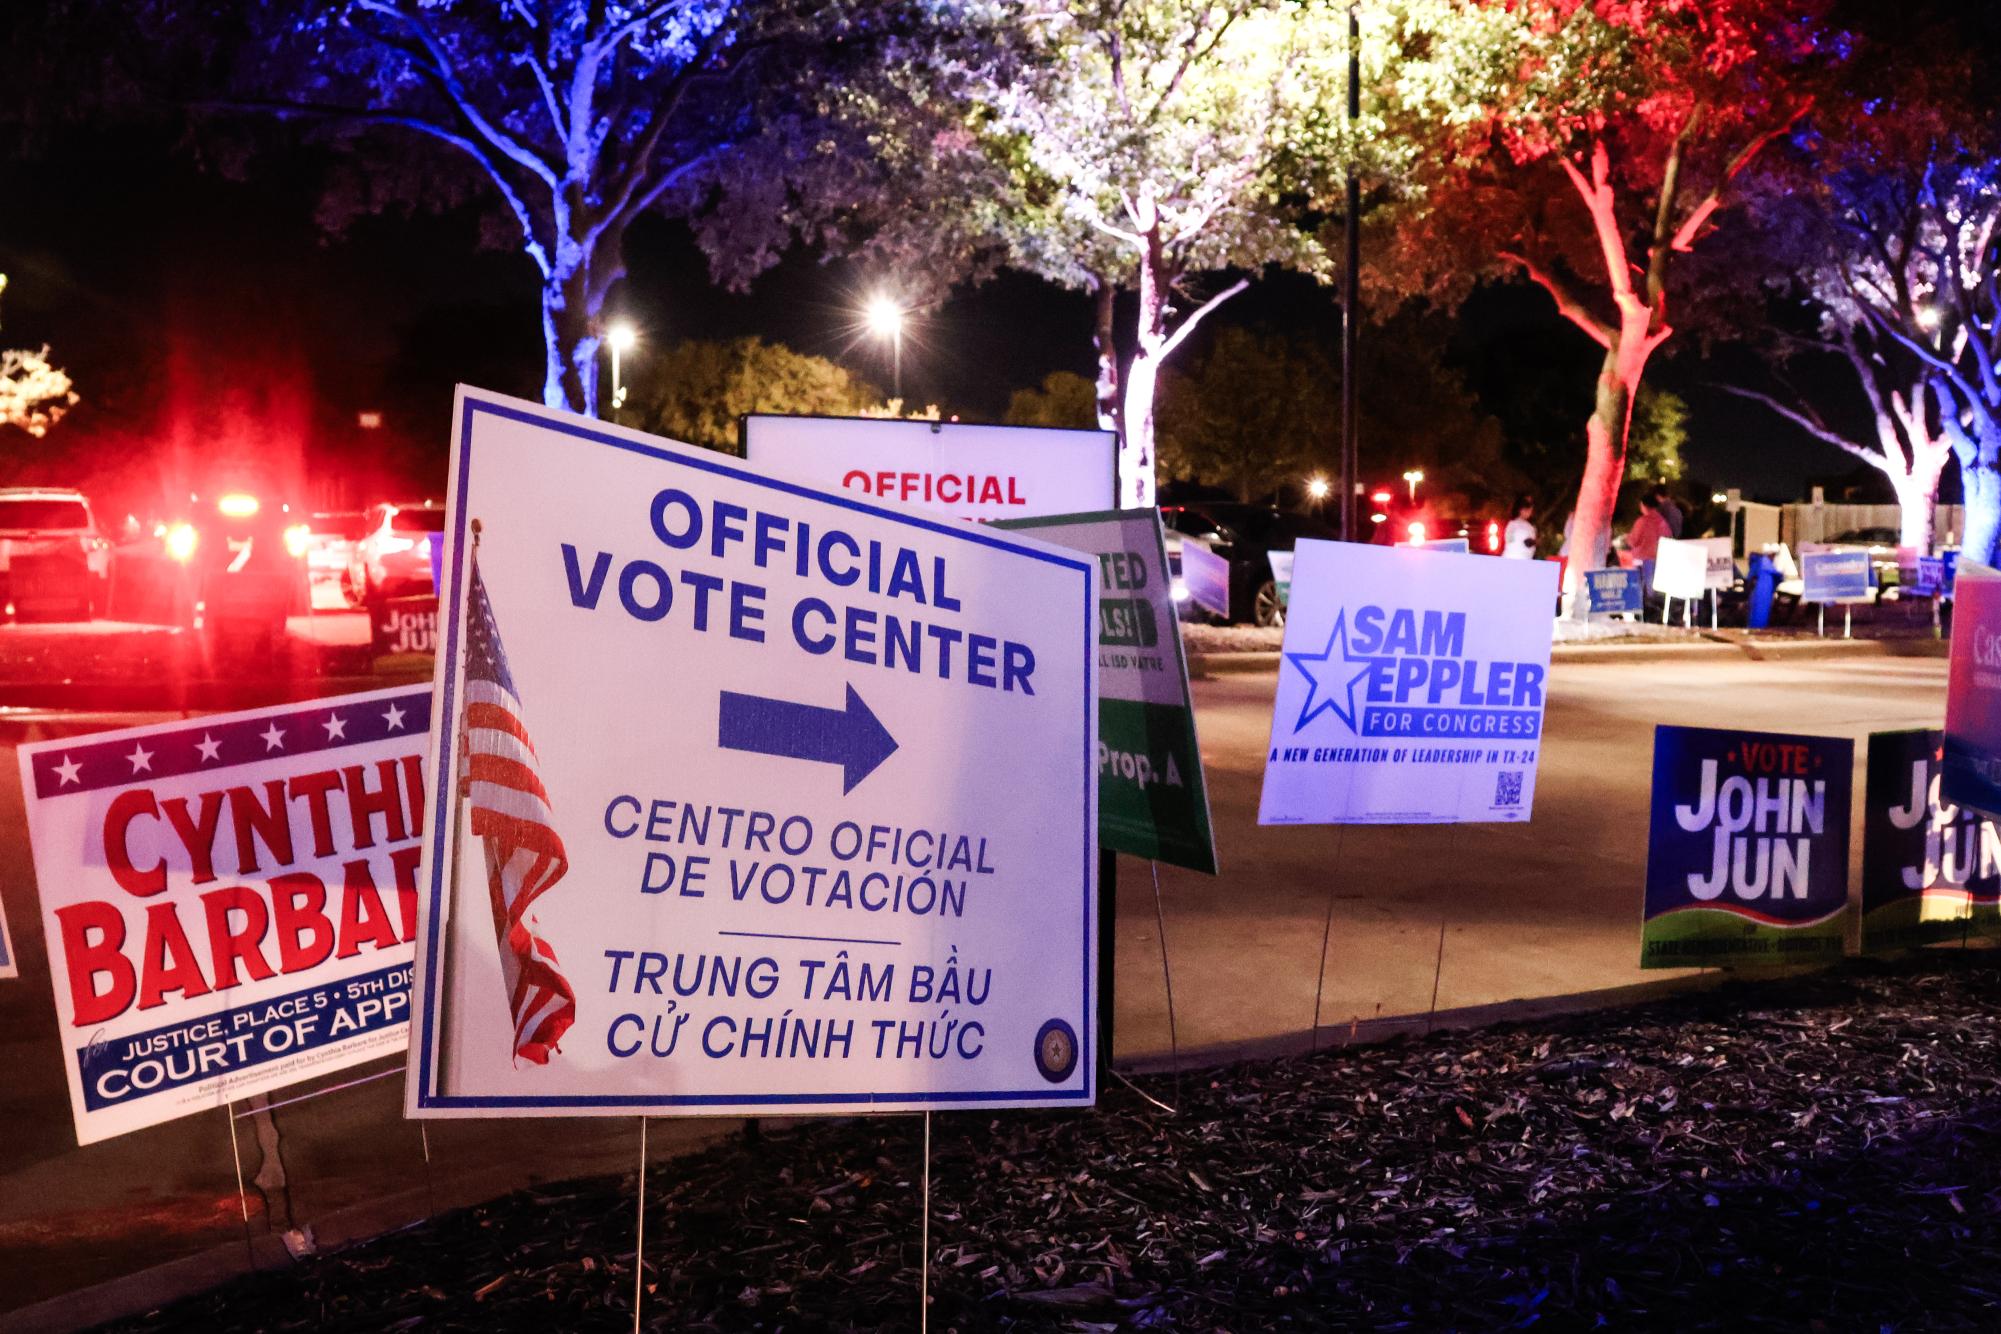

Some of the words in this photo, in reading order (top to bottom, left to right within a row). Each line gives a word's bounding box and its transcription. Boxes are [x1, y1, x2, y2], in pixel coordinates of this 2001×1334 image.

[842, 470, 1026, 505] OFFICIAL
[650, 488, 961, 612] OFFICIAL
[382, 610, 437, 632] JOH
[561, 543, 766, 643] VOTE
[791, 597, 1035, 695] CENTER
[1351, 605, 1466, 657] SAM
[1367, 657, 1545, 706] EPPLER
[1370, 712, 1412, 731] FOR
[1423, 713, 1535, 734] CONGRESS
[1270, 748, 1278, 763] A
[1283, 748, 1308, 763] NEW
[1313, 748, 1388, 763] GENERATION
[1393, 749, 1407, 763] OF
[1412, 749, 1482, 763] LEADERSHIP
[1487, 750, 1498, 763] IN
[1741, 742, 1809, 774] VOTE
[1675, 759, 1826, 834] JOHN
[604, 795, 813, 855] CENTRO
[830, 821, 995, 874] OFICIAL
[1687, 826, 1811, 900] JUN
[640, 852, 711, 898] DE
[730, 860, 967, 917] VOTACIÓN
[604, 950, 779, 998] TRUNG
[800, 950, 894, 1002] TÂM
[909, 944, 992, 1005] BẦU
[122, 1019, 229, 1060] JUSTICE,
[234, 996, 309, 1028] PLACE
[313, 991, 328, 1009] 5
[348, 979, 384, 999] 5TH
[606, 1000, 688, 1058] CỬ
[702, 1009, 853, 1058] CHÍNH
[871, 1009, 985, 1060] THỨC
[96, 1033, 257, 1099] COURT
[263, 1014, 320, 1052] OF
